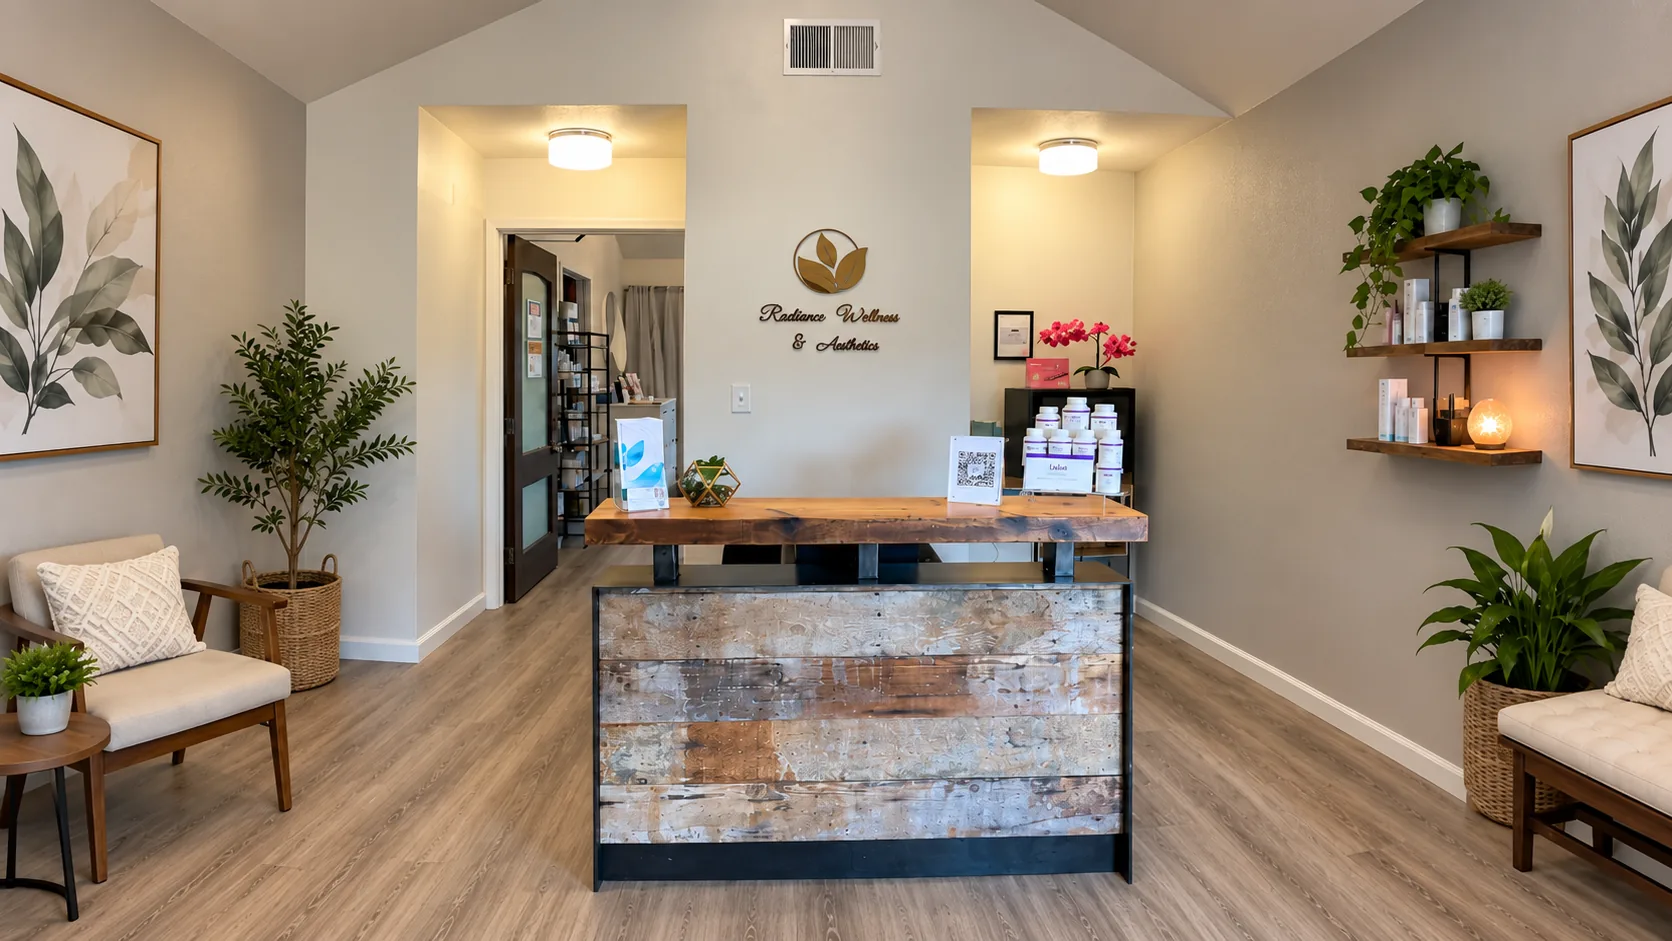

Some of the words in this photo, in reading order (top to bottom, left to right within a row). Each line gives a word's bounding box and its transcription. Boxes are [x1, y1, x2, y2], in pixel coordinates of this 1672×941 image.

[759, 303, 826, 322] Radiance
[836, 303, 900, 323] Wellness
[792, 333, 806, 350] &
[816, 336, 880, 351] Aesthetics
